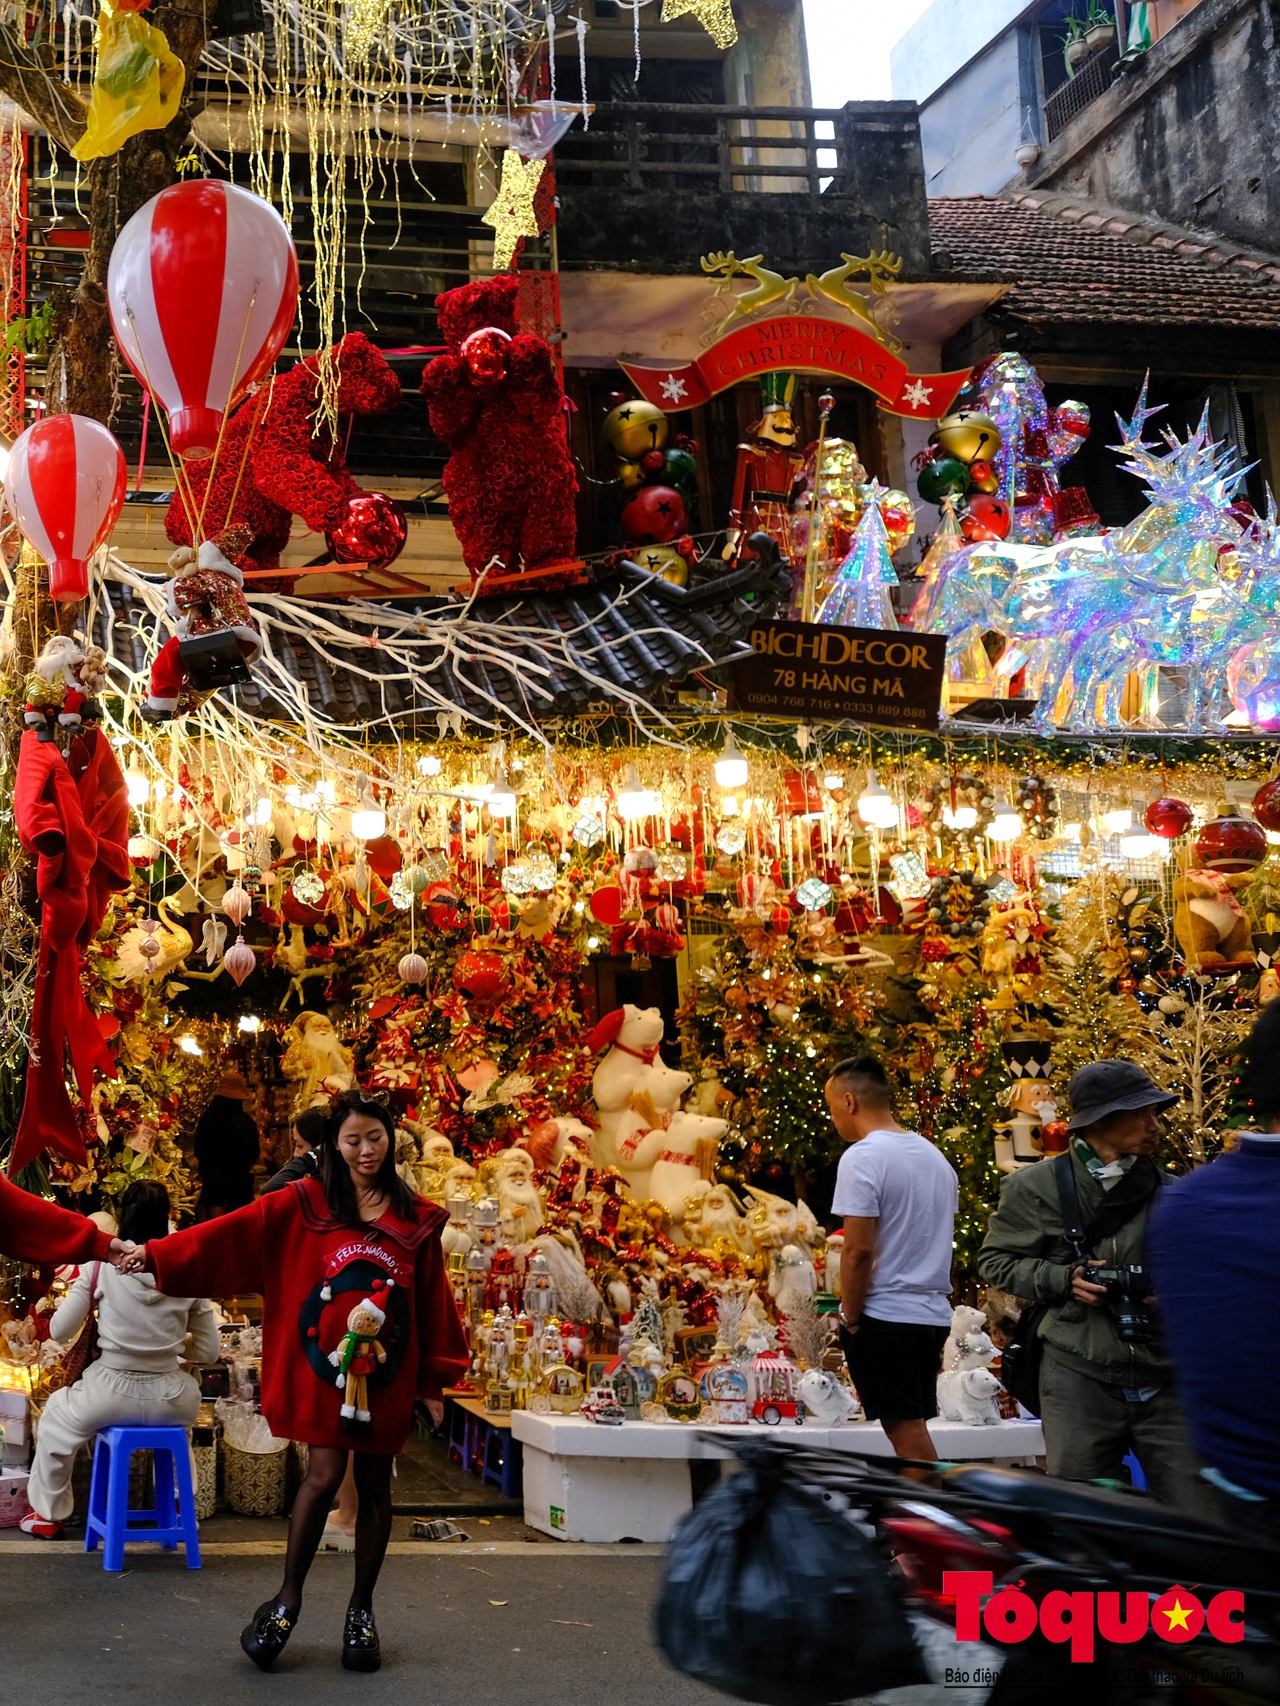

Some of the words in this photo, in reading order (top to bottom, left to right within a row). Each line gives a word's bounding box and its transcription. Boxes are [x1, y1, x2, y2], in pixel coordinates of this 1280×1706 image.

[756, 321, 845, 345] MERRY
[719, 343, 888, 382] CHRISTMAS
[750, 627, 933, 670] BÍCHDECOR
[773, 668, 796, 688] 78
[802, 669, 867, 694] HÀNG
[873, 677, 905, 698] MÃ
[747, 692, 778, 705] 0904
[782, 695, 805, 707] 766
[810, 698, 831, 710] 716
[843, 701, 874, 713] 0333
[877, 705, 900, 717] 889
[904, 707, 926, 719] 888
[336, 1243, 363, 1263] FELIZ
[363, 1245, 396, 1268] NAVIDAD
